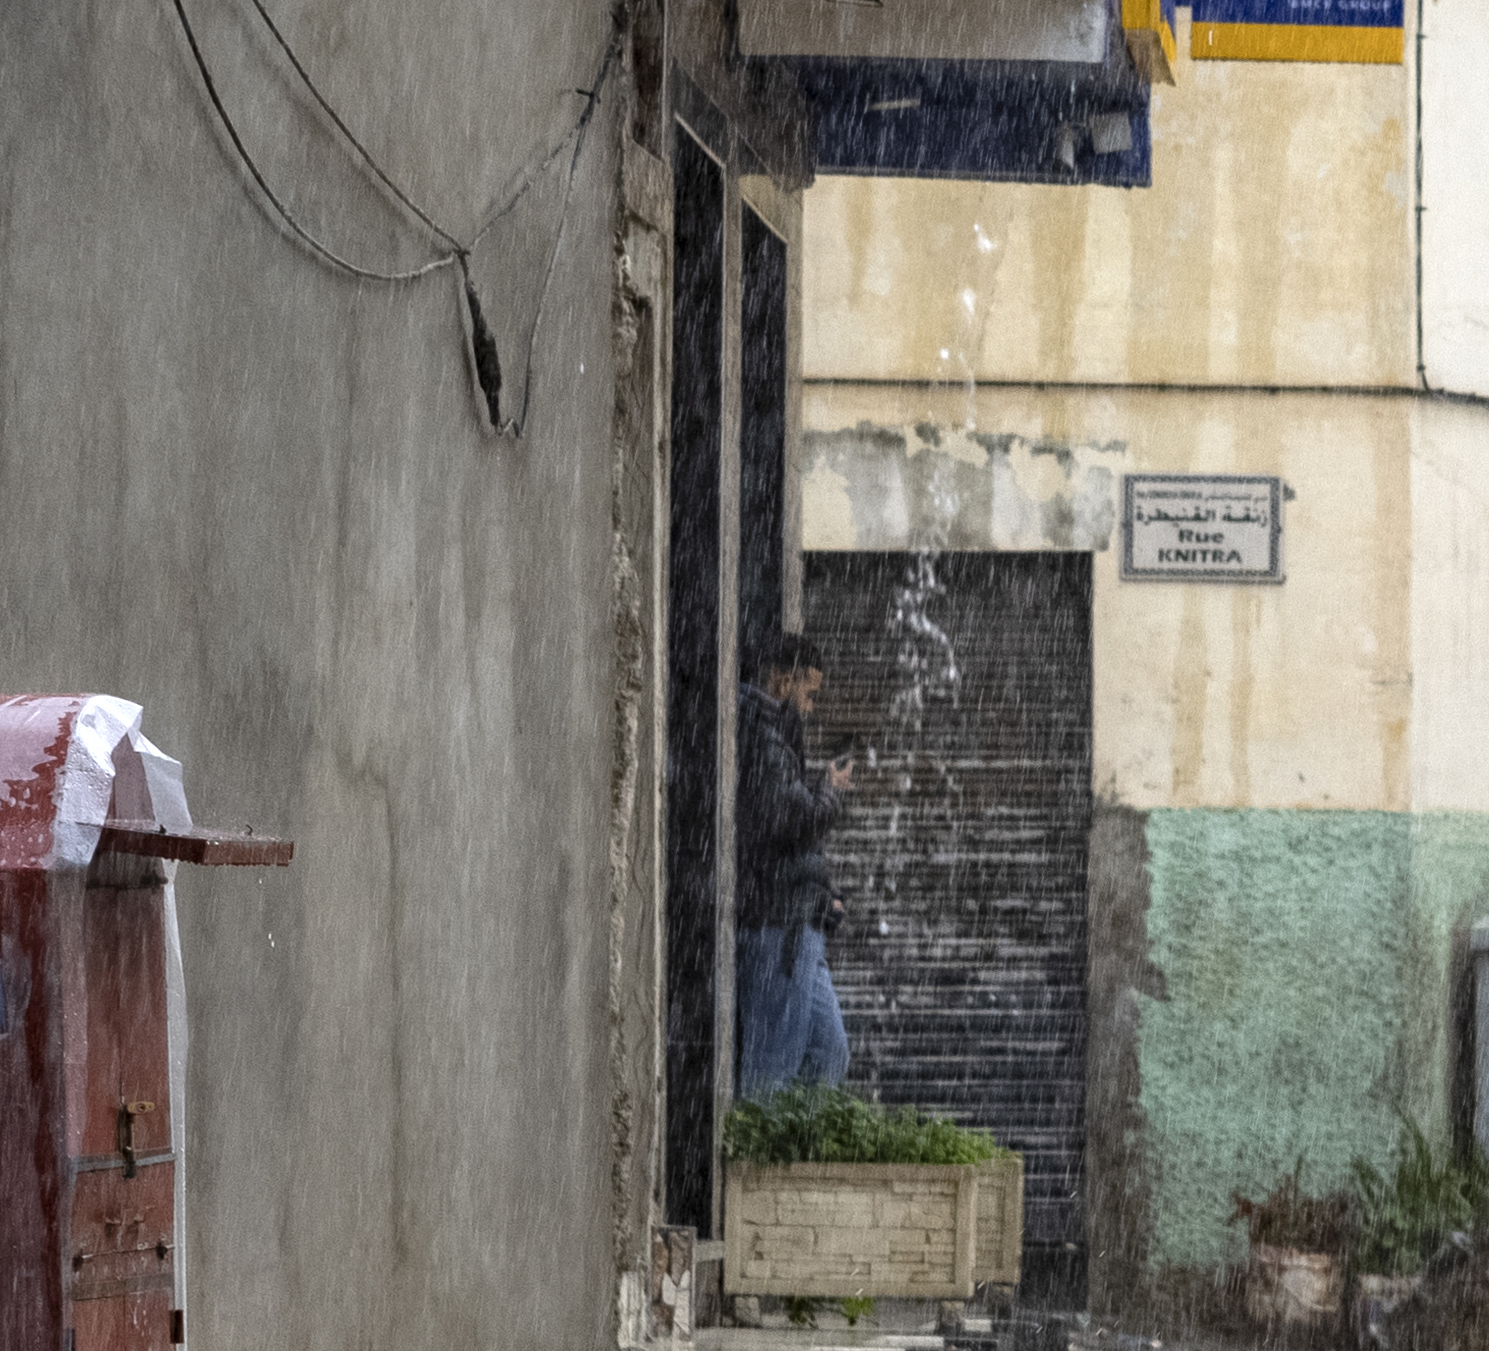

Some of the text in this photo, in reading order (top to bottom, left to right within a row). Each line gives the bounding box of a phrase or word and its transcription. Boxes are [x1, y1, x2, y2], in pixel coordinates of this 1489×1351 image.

[1222, 505, 1268, 528] زنقة
[1178, 528, 1225, 544] Rue
[1158, 548, 1242, 563] KNITRA
